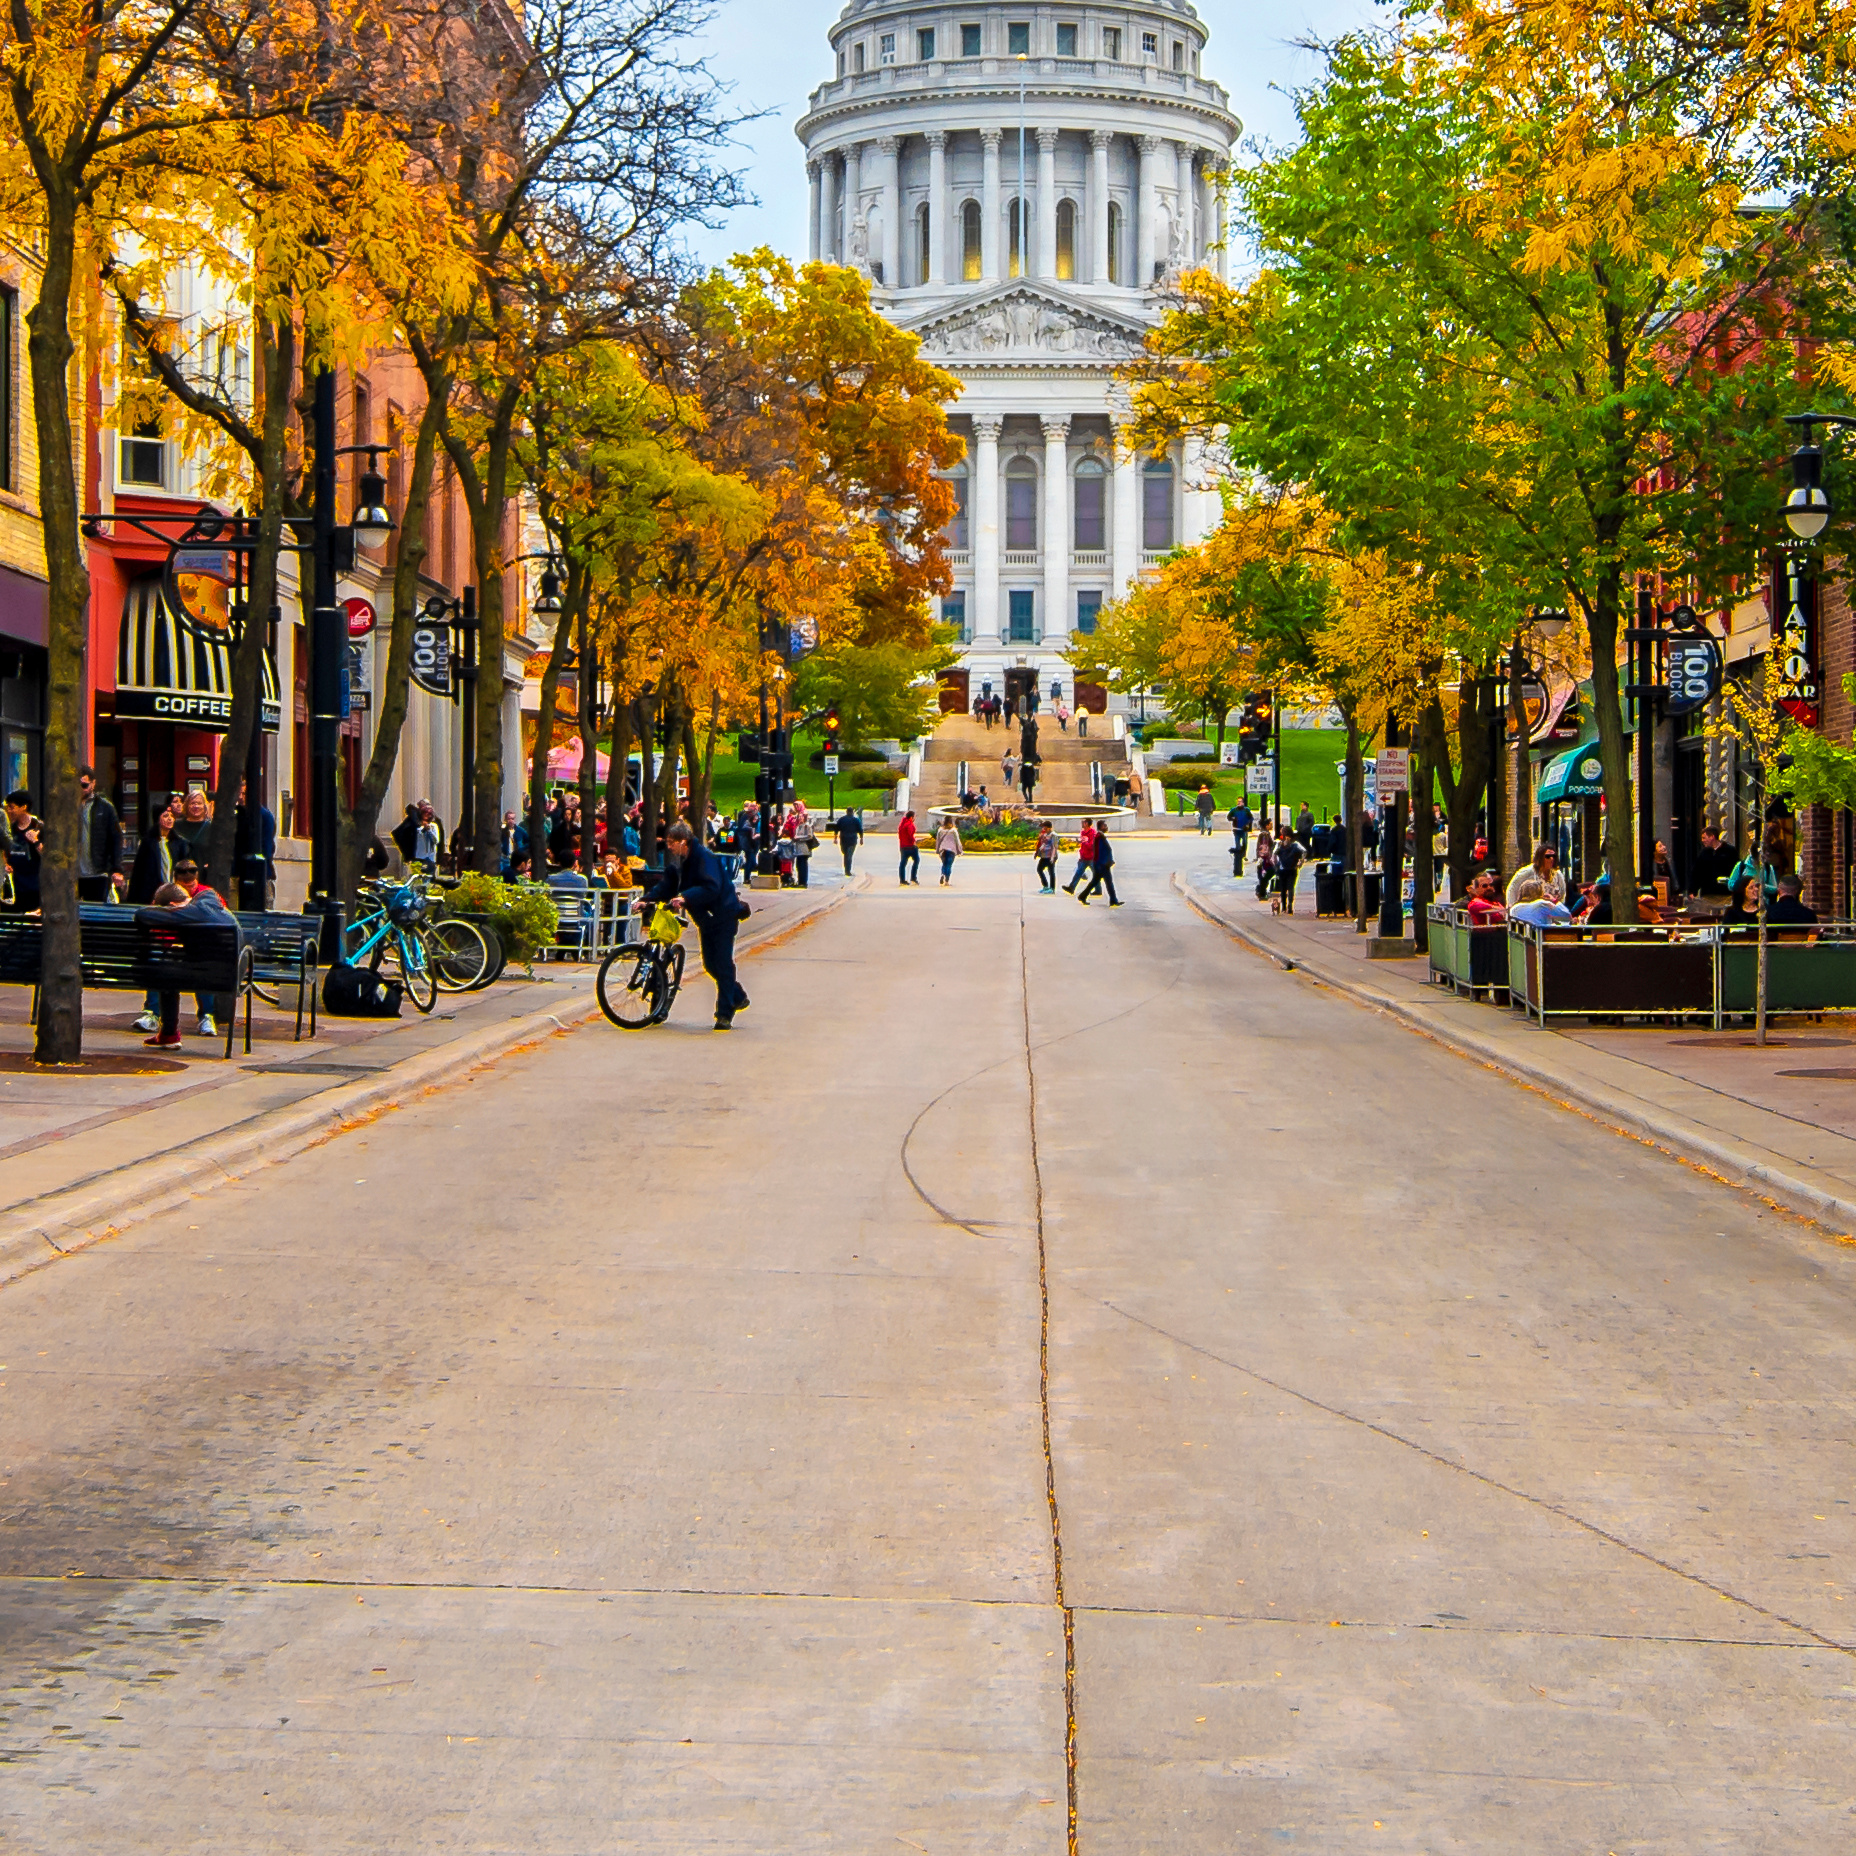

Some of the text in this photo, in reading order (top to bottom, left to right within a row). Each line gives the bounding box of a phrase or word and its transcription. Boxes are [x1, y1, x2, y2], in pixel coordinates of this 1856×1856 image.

[414, 630, 436, 676] 100
[437, 639, 449, 681] BLOCK
[1669, 652, 1683, 698] BLOCK
[1684, 643, 1709, 700] 100
[154, 696, 231, 716] COFFEE
[1778, 685, 1816, 698] BAR
